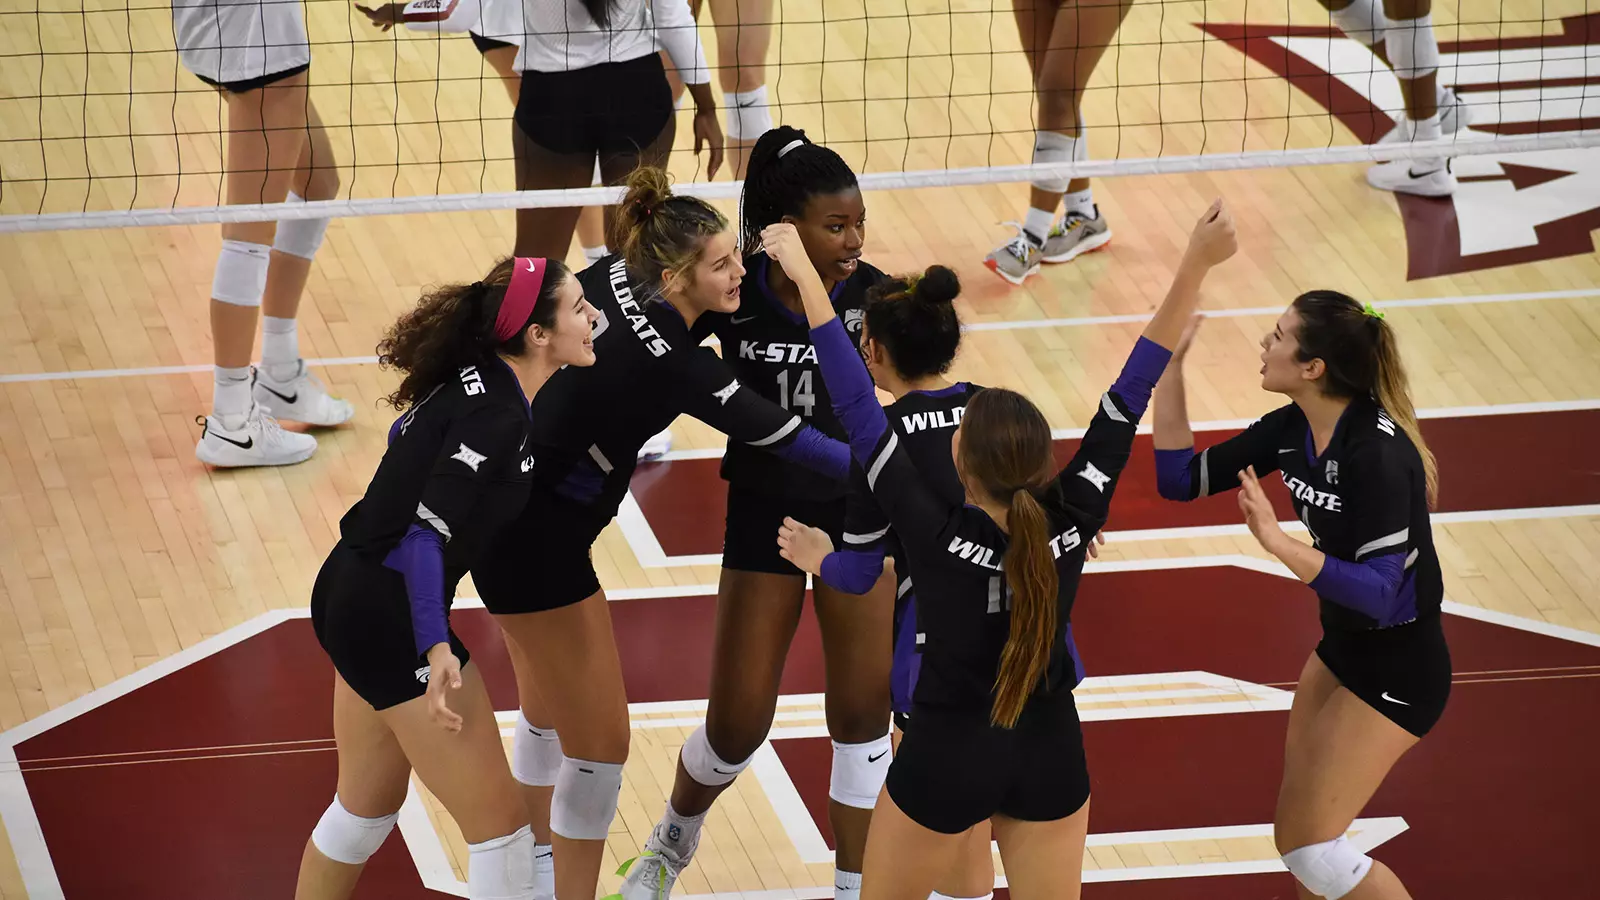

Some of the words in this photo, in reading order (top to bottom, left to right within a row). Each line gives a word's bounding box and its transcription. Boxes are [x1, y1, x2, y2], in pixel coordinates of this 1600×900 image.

[609, 258, 672, 357] WILDCATS
[739, 340, 819, 365] K-STA
[776, 369, 816, 416] 14
[1280, 470, 1342, 513] STATE
